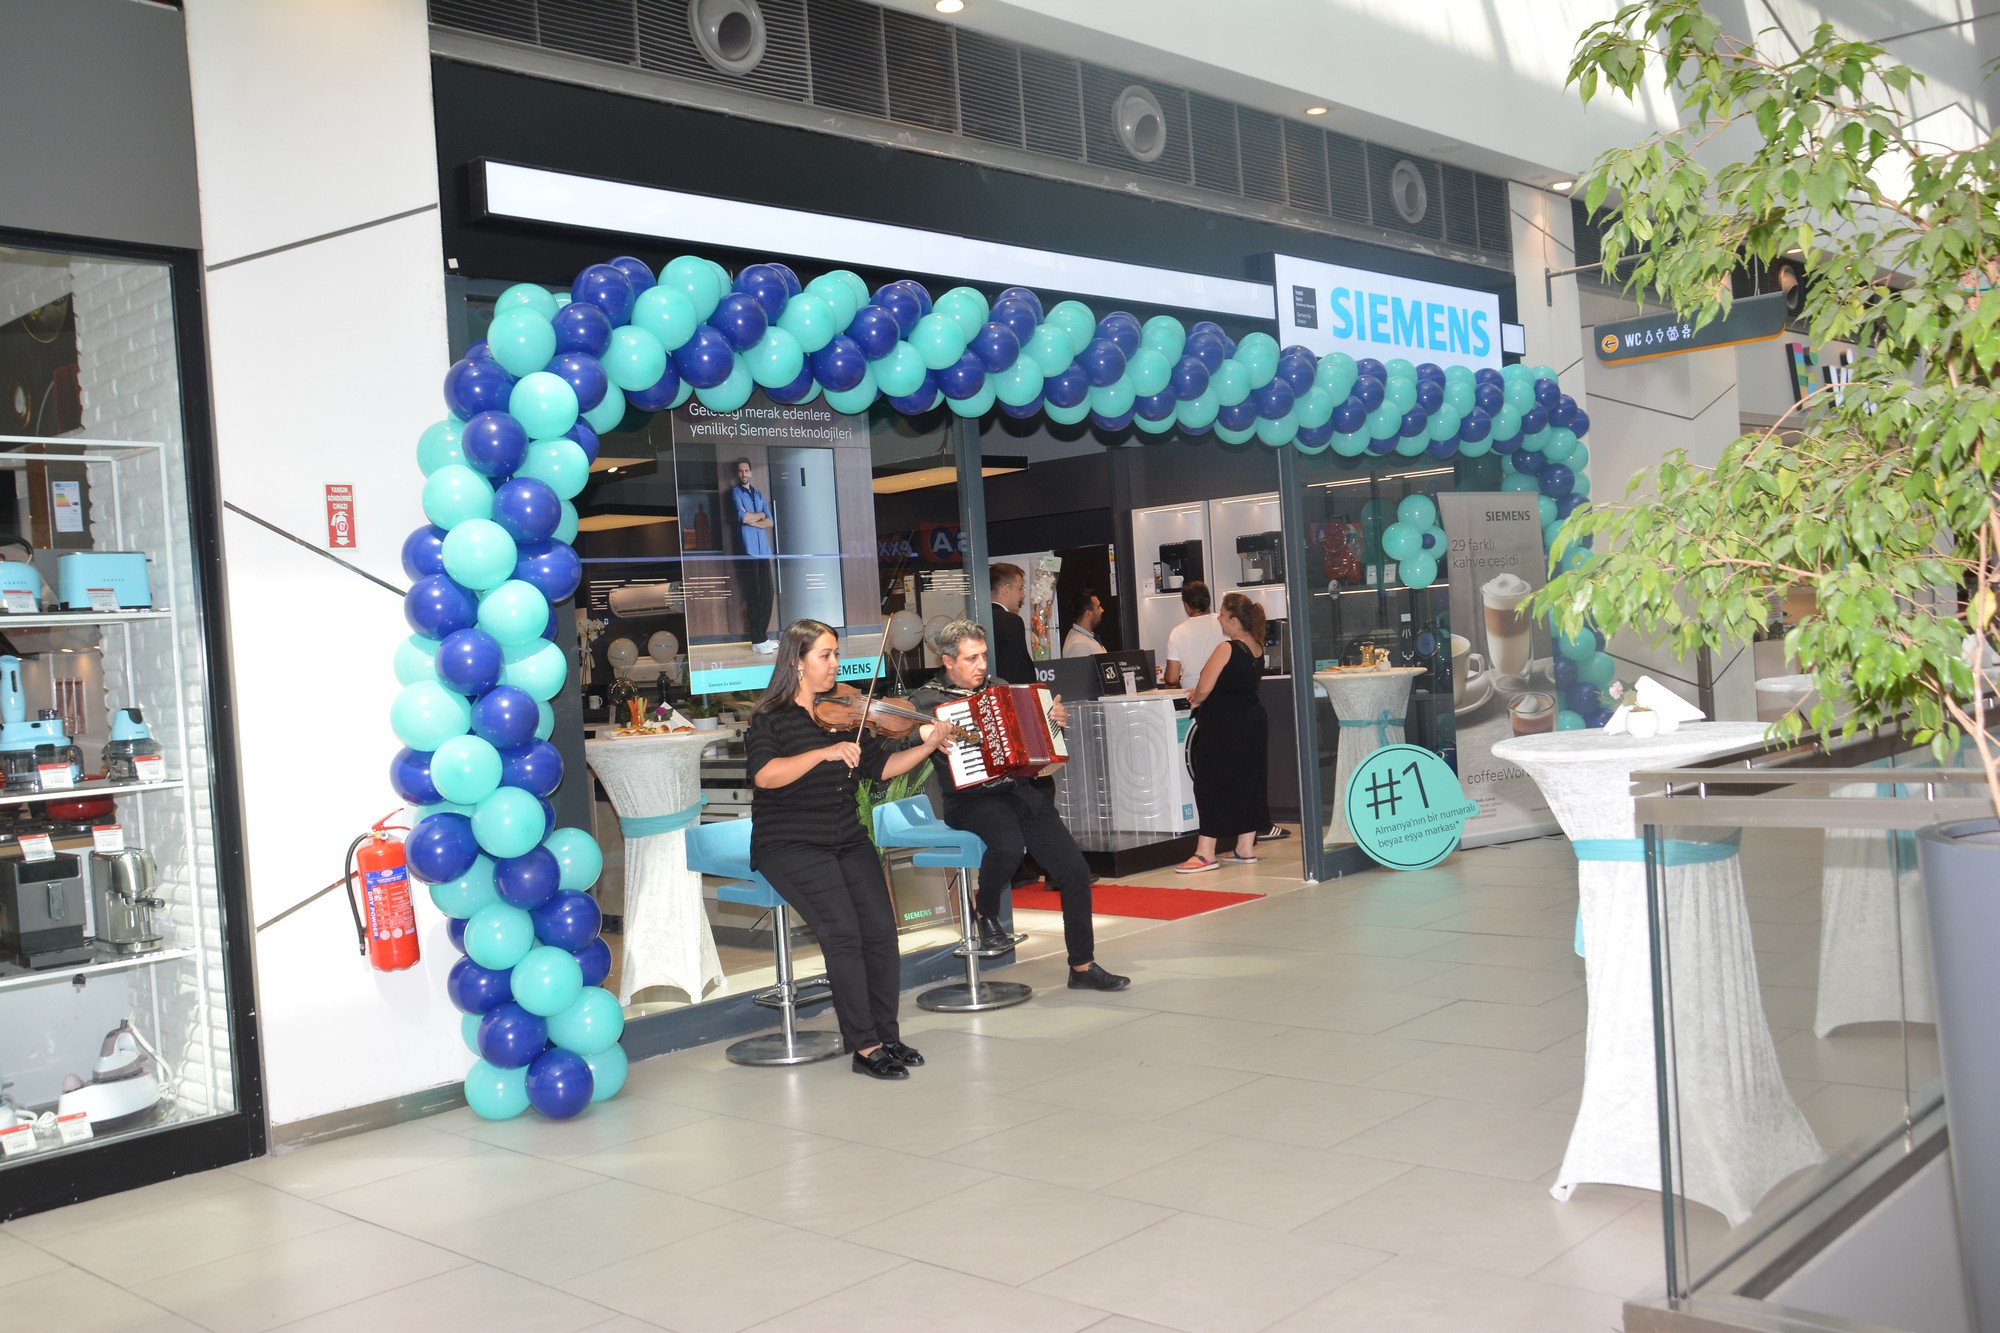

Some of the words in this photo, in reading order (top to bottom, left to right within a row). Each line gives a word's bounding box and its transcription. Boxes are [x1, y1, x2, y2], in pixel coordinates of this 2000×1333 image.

[1330, 286, 1490, 357] SIEMENS
[1624, 332, 1642, 348] WC
[745, 407, 780, 420] merak
[782, 408, 831, 421] edenlere
[690, 423, 738, 437] yenilikçi
[740, 424, 788, 438] Siemens
[789, 426, 852, 442] teknolojileri
[1485, 510, 1531, 521] SIEMENS
[1452, 539, 1466, 551] 29
[1468, 538, 1495, 551] farklı
[1453, 556, 1486, 568] kahve
[1487, 554, 1519, 569] çeşidi
[837, 662, 872, 676] EMENS
[1365, 761, 1430, 820] #1
[1375, 817, 1427, 836] Almanya'nın
[1427, 813, 1439, 824] bir
[1440, 804, 1476, 820] numaralı
[1378, 834, 1404, 848] beyaz
[1404, 832, 1424, 844] eşya
[367, 891, 375, 905] DRY
[370, 907, 379, 937] POWDER
[904, 908, 932, 921] SIEMENS
